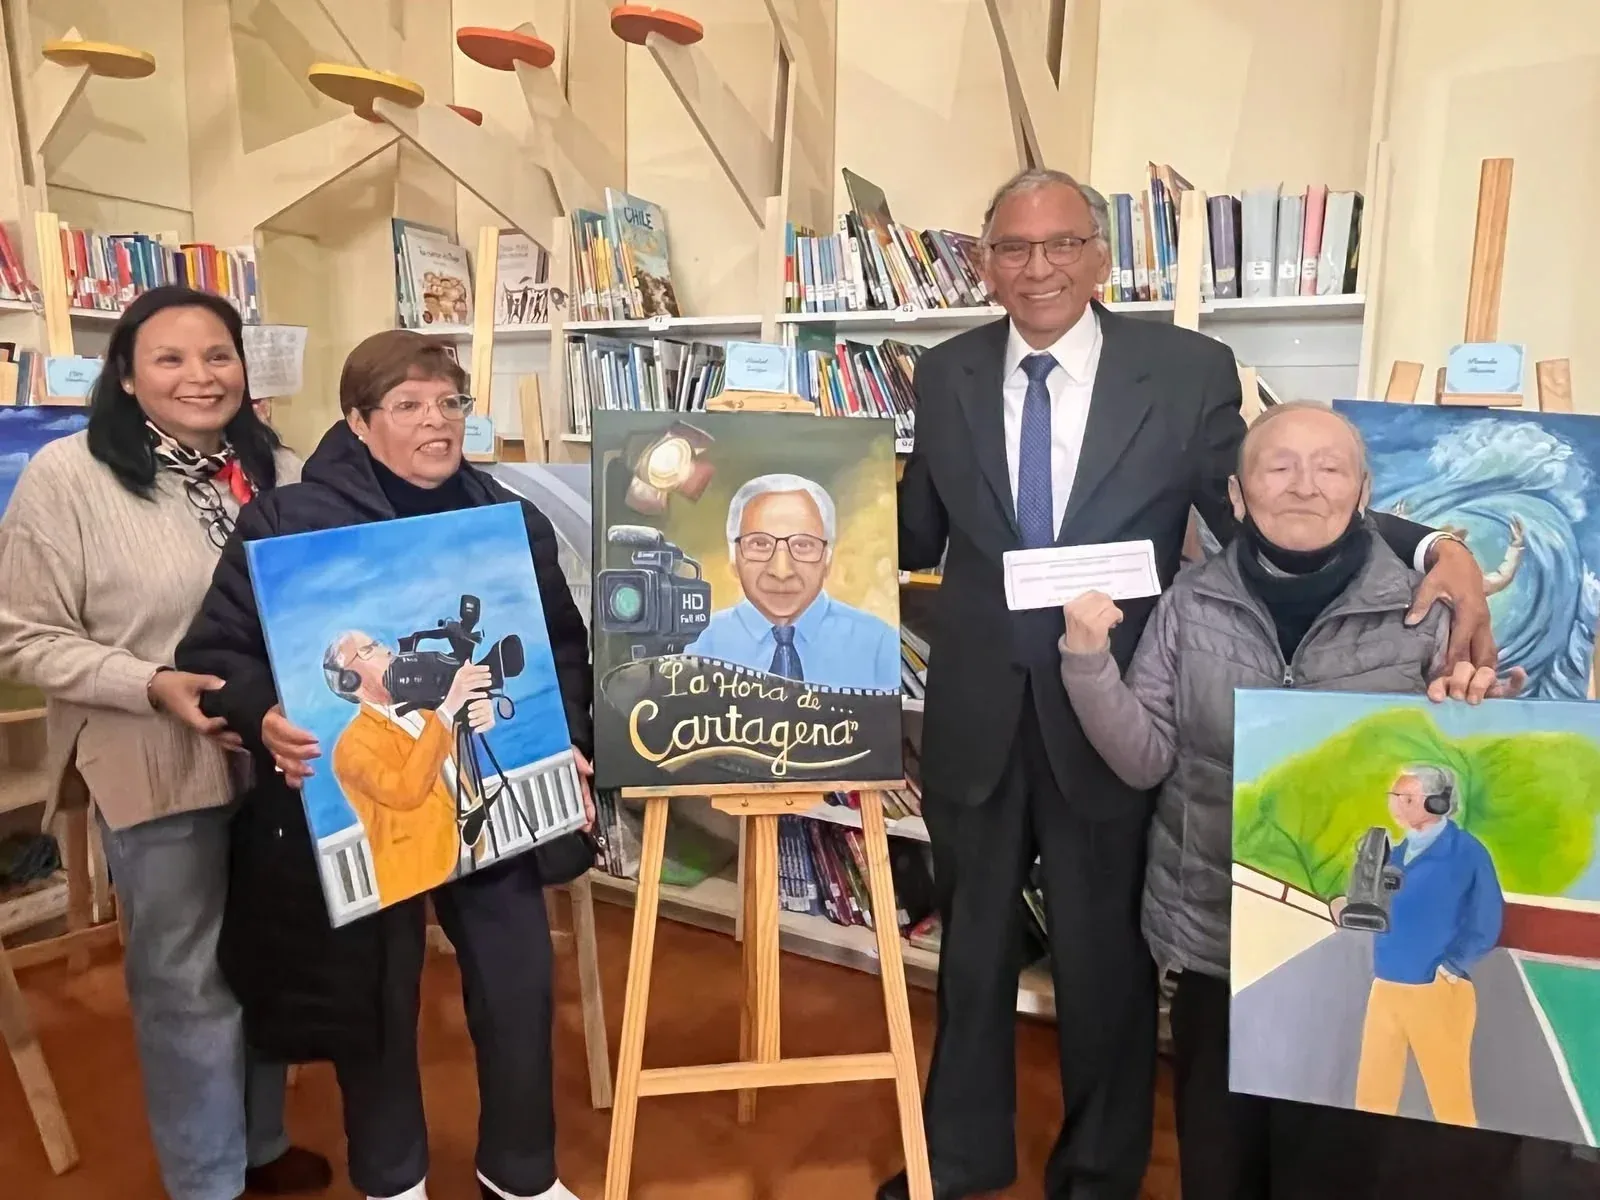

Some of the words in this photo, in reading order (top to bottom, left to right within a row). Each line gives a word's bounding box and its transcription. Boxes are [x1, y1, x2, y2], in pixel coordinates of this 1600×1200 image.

[623, 206, 654, 230] CHILE
[682, 593, 704, 610] HD
[713, 671, 788, 702] Hora
